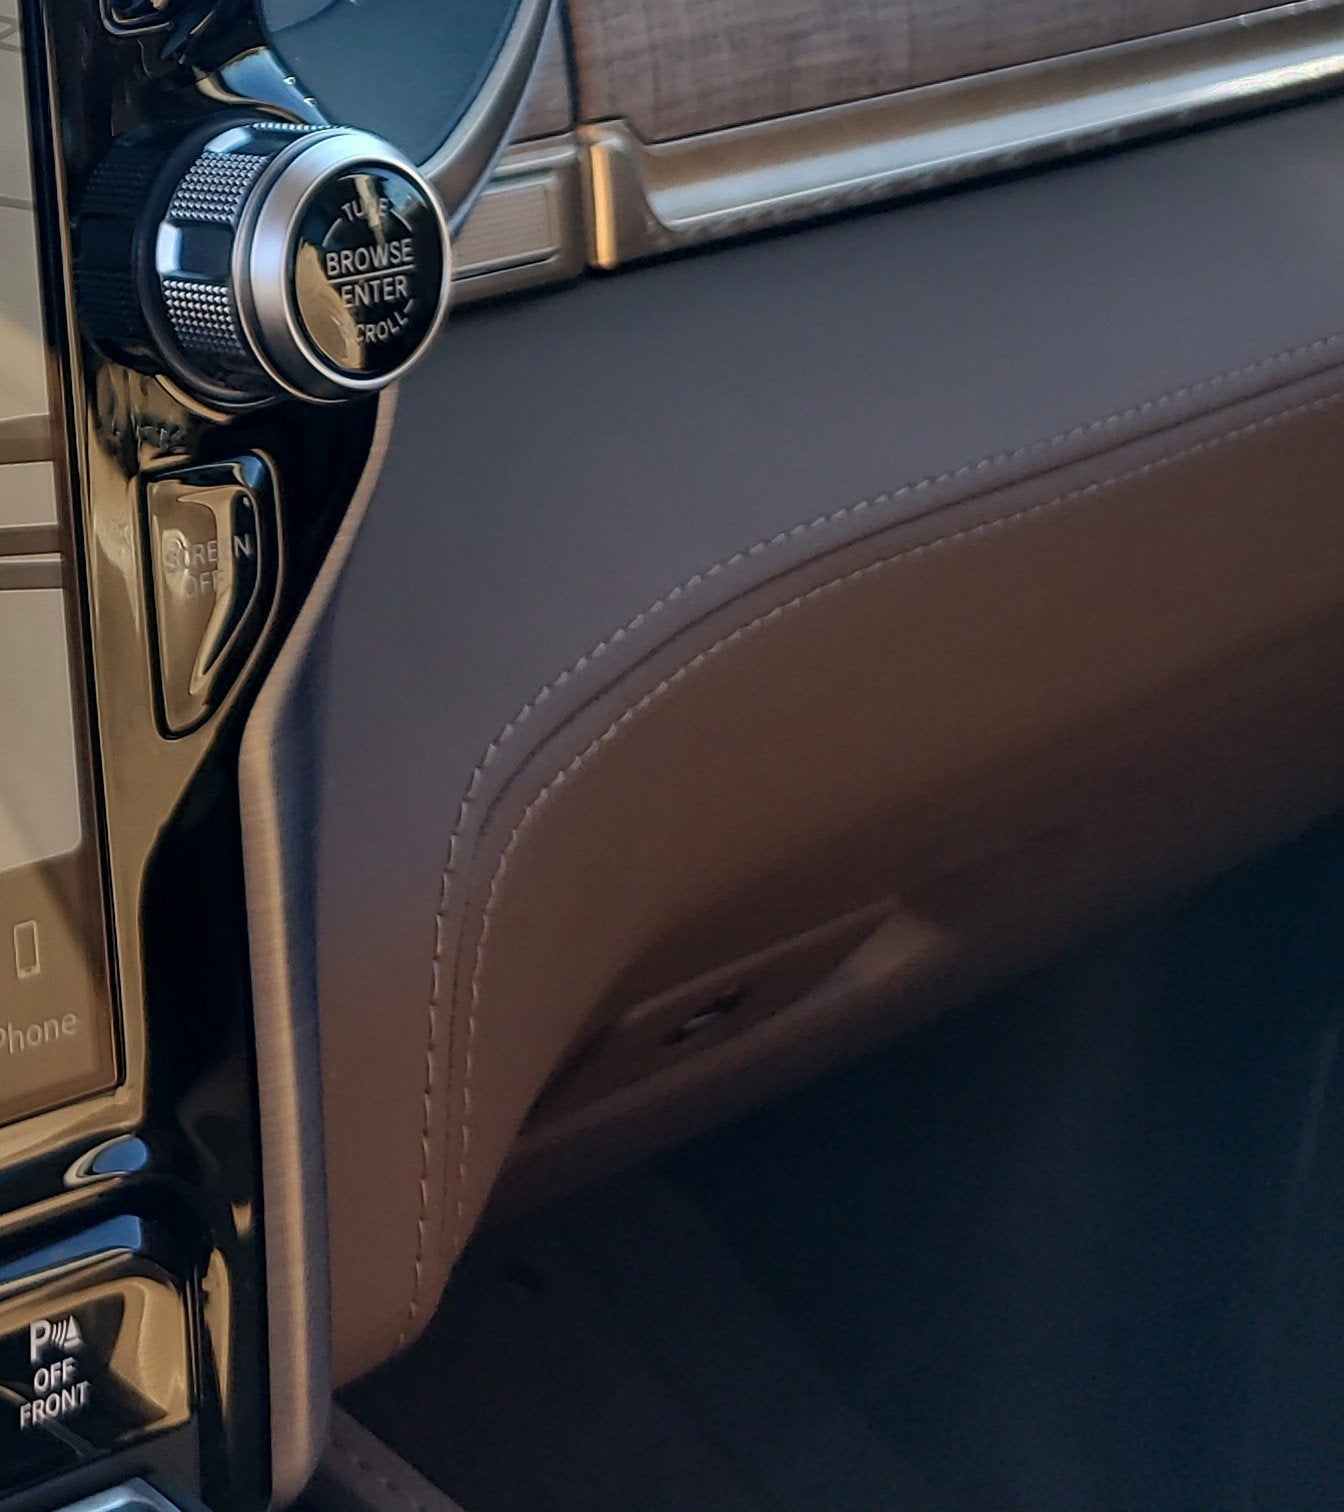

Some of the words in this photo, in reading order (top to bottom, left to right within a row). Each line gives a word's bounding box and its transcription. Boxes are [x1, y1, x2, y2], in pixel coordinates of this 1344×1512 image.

[340, 196, 390, 222] TUE
[325, 239, 413, 277] BROWSE
[340, 275, 409, 308] ENTER
[353, 310, 411, 344] CROLL
[164, 533, 254, 574] SREN
[33, 1356, 78, 1393] OFF
[19, 1379, 92, 1432] FRONT
